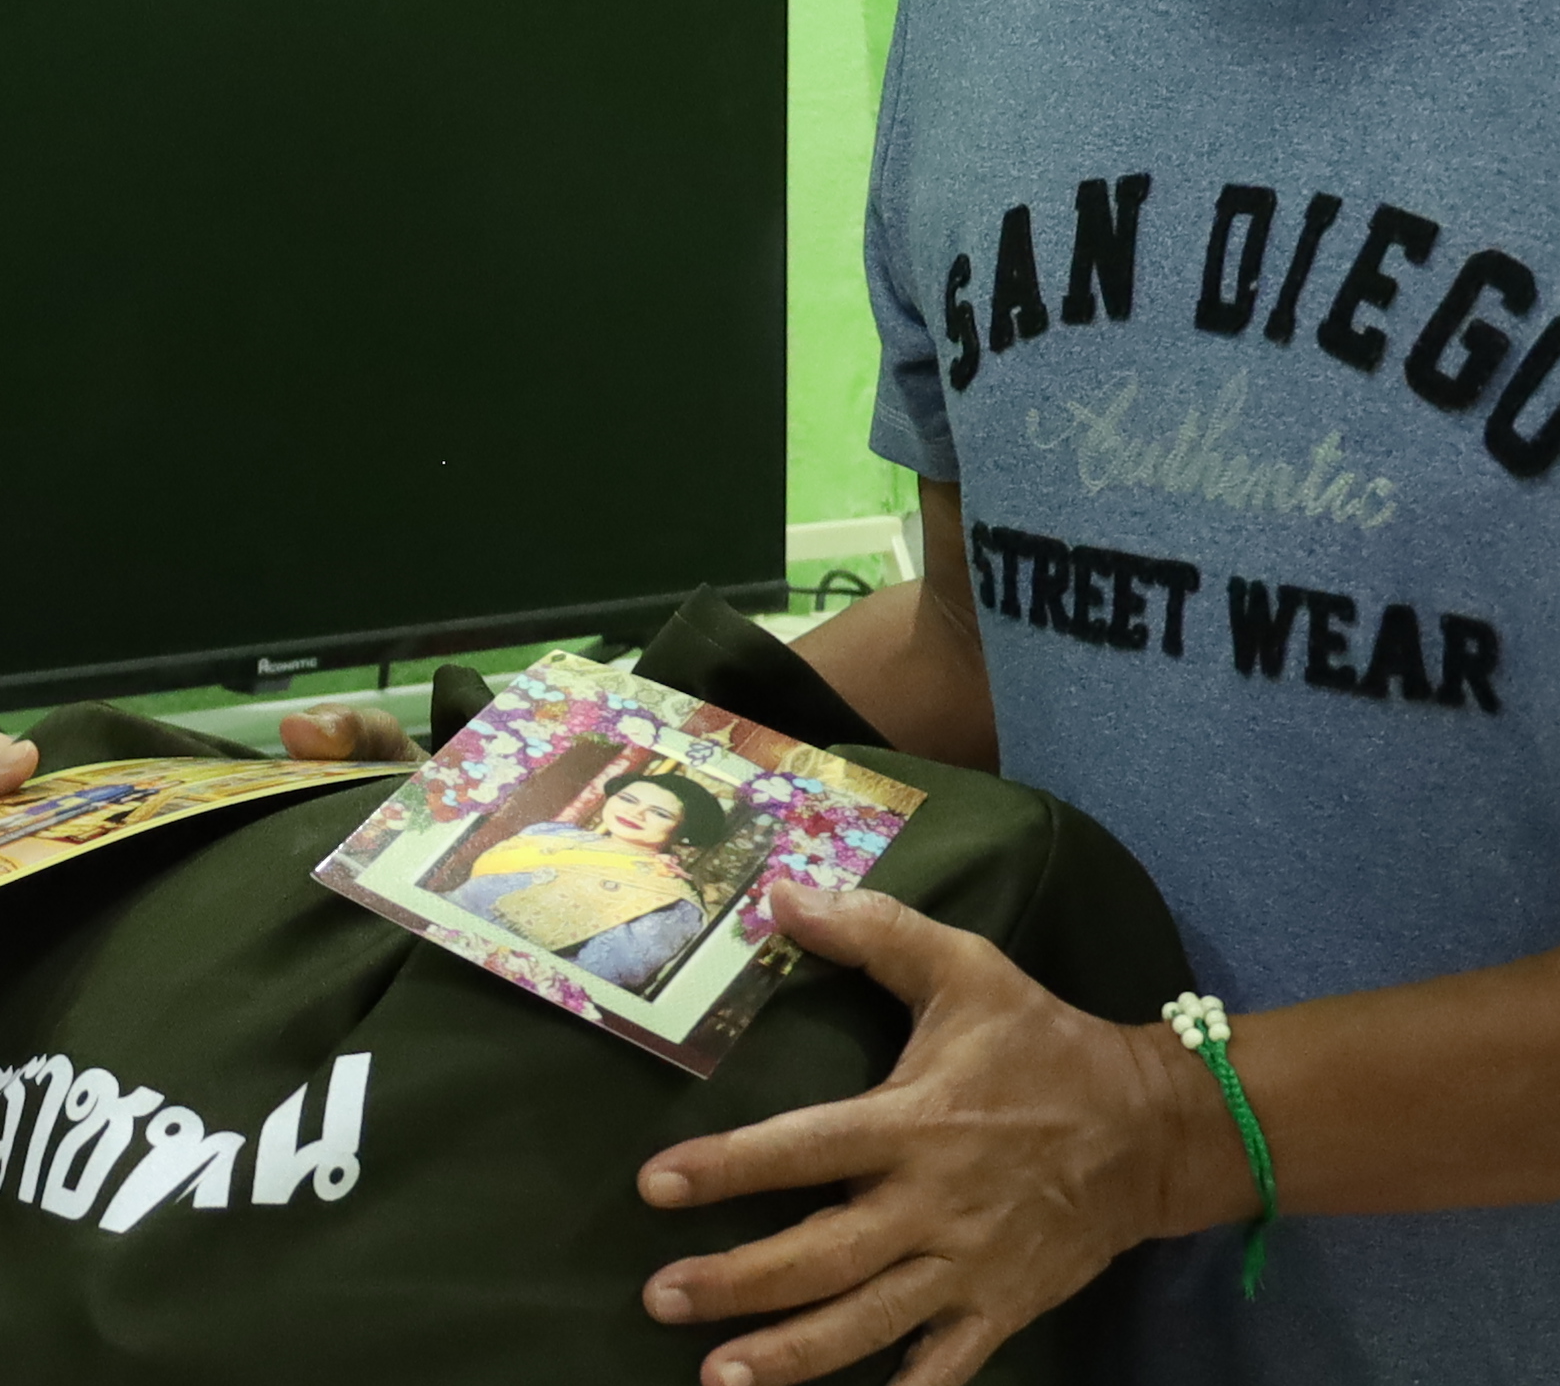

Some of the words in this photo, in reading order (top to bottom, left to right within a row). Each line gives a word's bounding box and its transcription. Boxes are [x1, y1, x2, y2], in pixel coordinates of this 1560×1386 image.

[944, 172, 1151, 392] SAN
[971, 519, 1200, 658] STREET
[1226, 574, 1504, 717] WEAR
